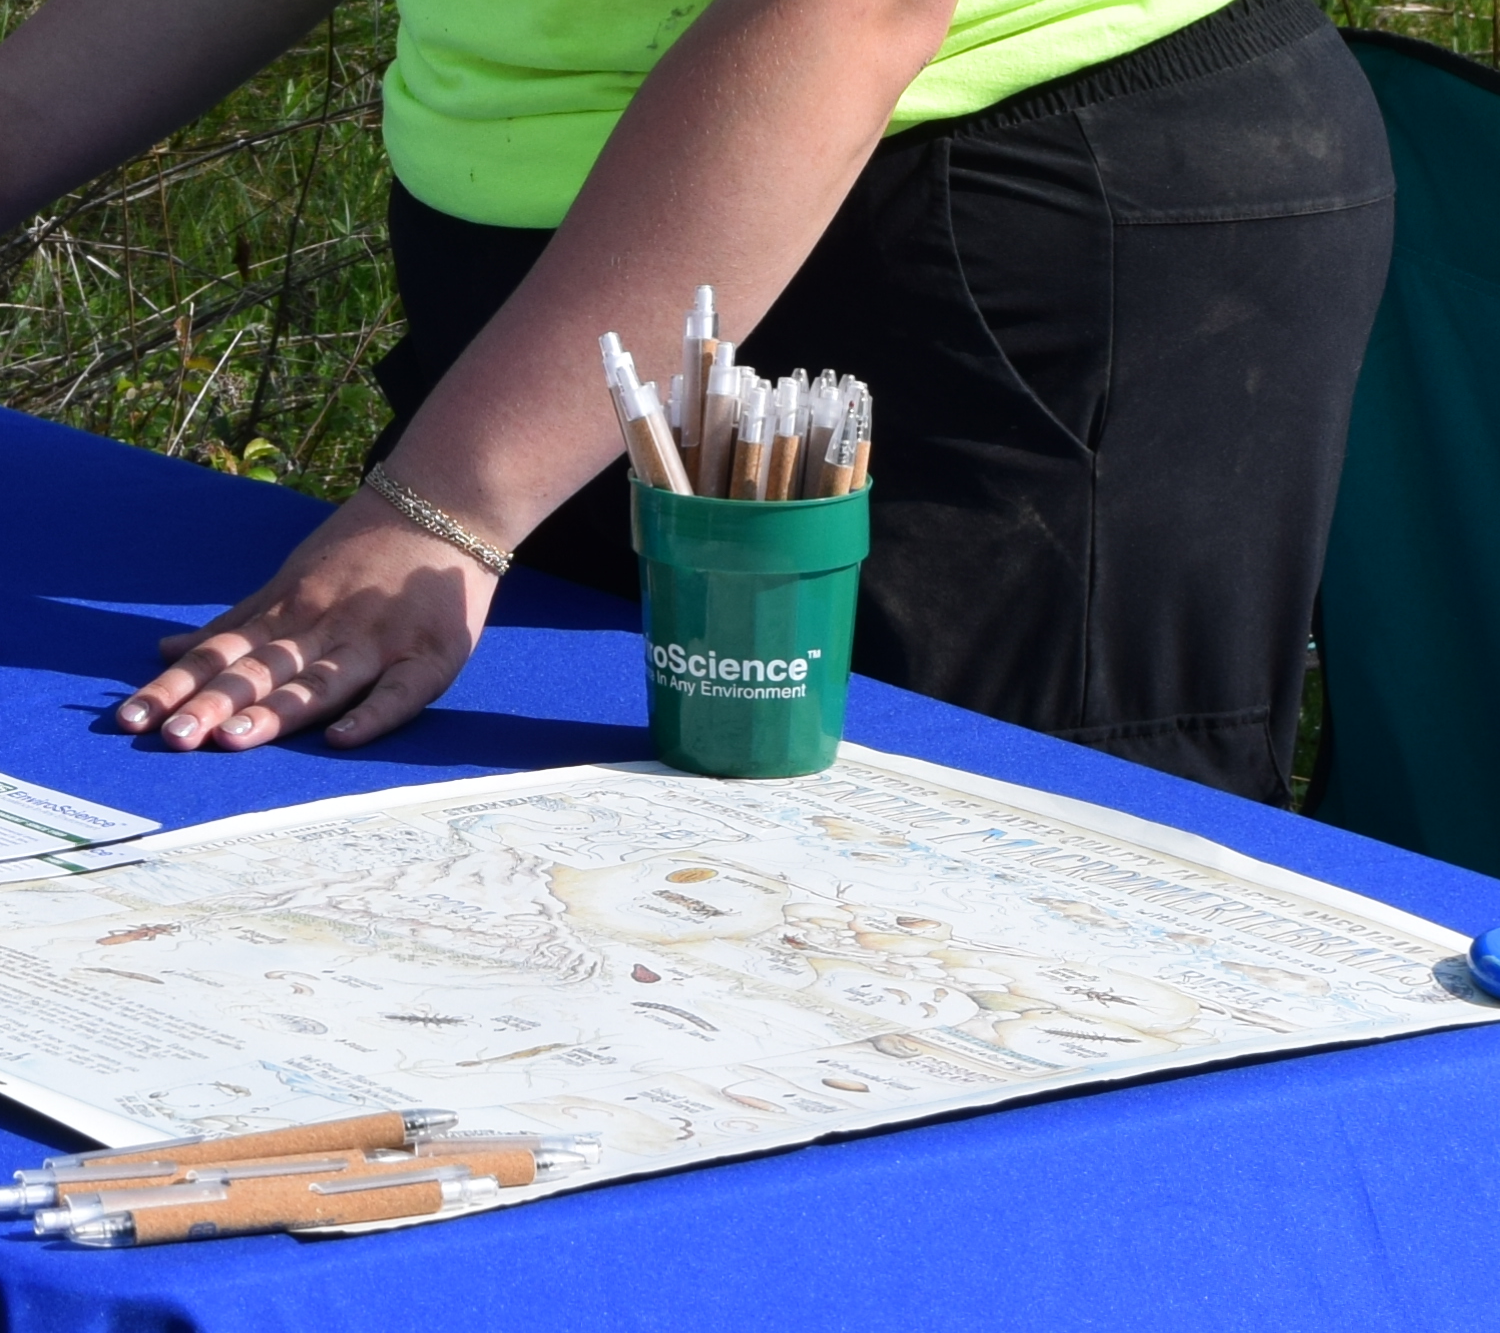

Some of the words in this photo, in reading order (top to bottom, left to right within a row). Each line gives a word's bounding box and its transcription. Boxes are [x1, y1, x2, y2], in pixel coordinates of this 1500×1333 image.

[656, 669, 668, 687] In
[669, 674, 697, 697] Any
[700, 680, 807, 700] Environment
[7, 790, 116, 828] EnviroScience
[654, 790, 782, 830] WATERSHED
[187, 832, 278, 853] VELOCITY
[941, 797, 981, 810] OF
[979, 808, 1065, 837] WATER
[1062, 832, 1165, 868] QUALITY
[1163, 869, 1208, 882] IN
[1211, 882, 1297, 909] NORTH
[1299, 908, 1434, 958] AMERICAN
[1051, 879, 1130, 908] animals
[1135, 906, 1214, 936] without
[1177, 969, 1283, 1008] RIFFLE
